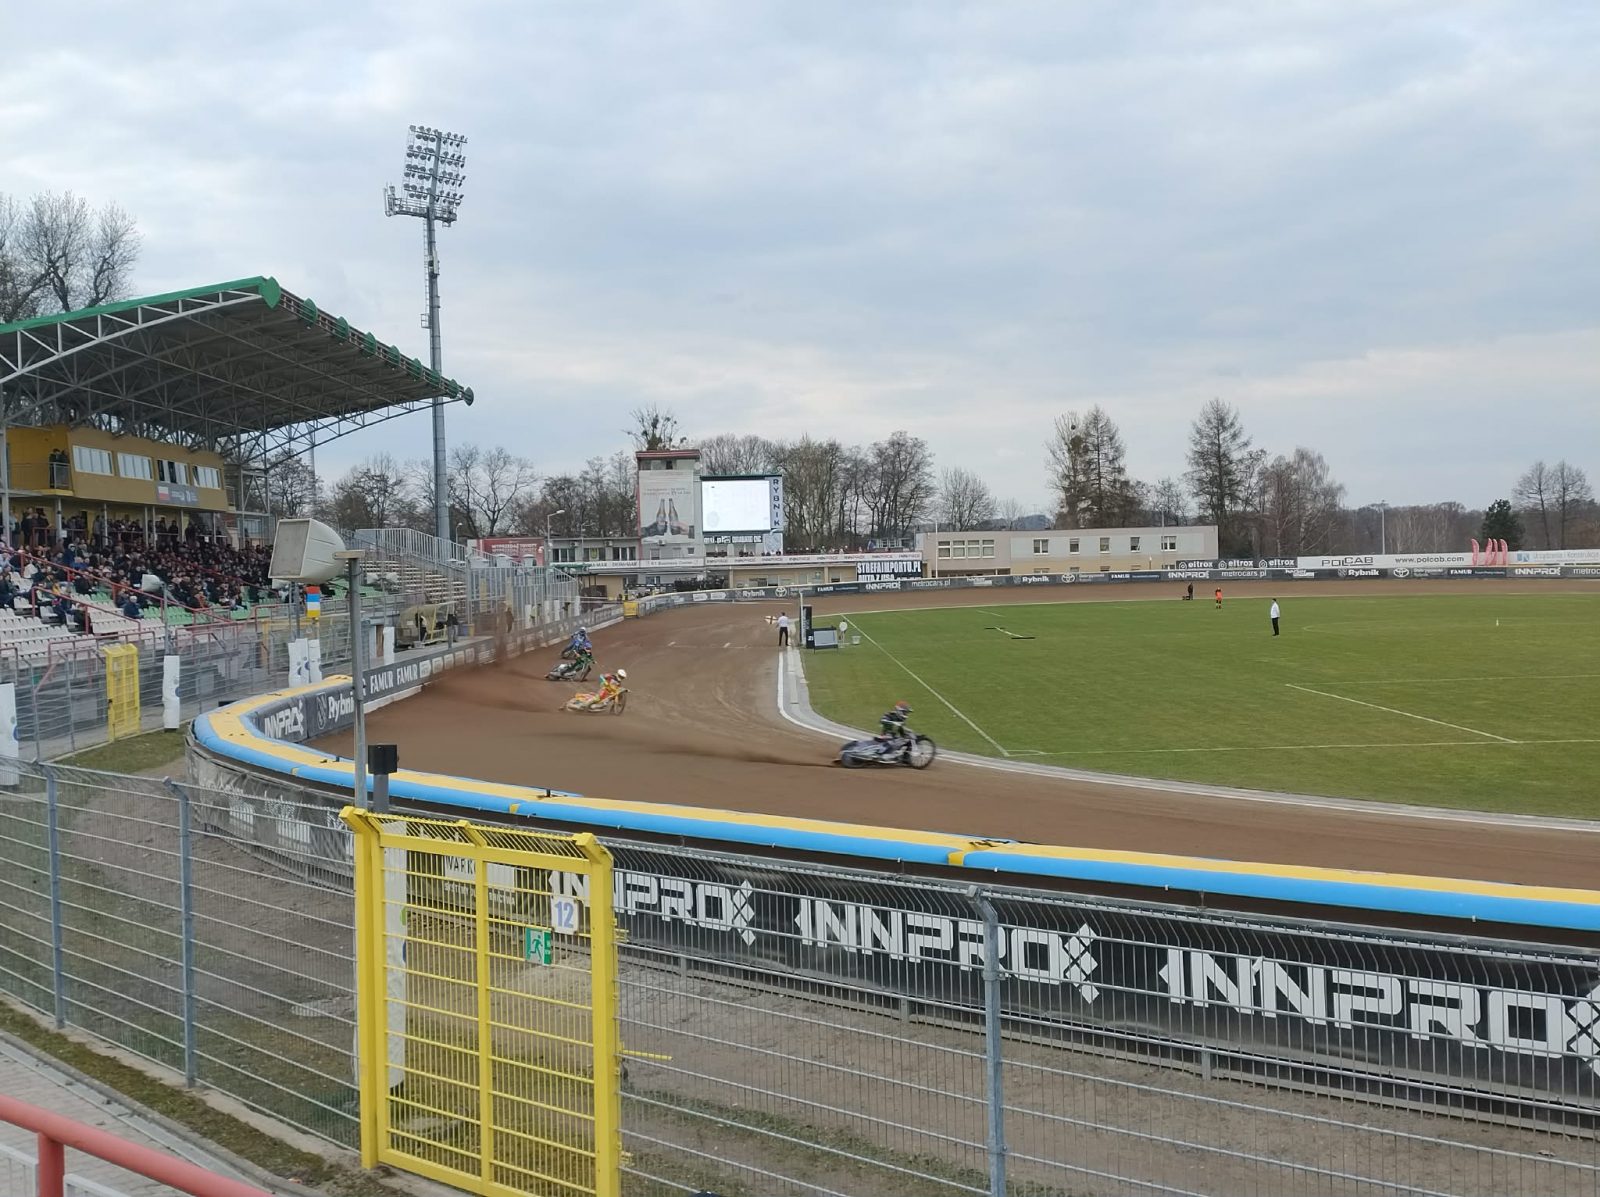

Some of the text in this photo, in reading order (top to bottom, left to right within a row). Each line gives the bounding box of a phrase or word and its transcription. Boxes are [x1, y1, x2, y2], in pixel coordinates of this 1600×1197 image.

[857, 561, 921, 573] STREFAIMPORTU.PL
[1322, 557, 1373, 566] POLCAB
[1348, 569, 1379, 577] Rybnik
[370, 670, 394, 695] FAMUR
[396, 663, 418, 686] FAMUR
[328, 691, 354, 722] Rybni
[555, 902, 574, 929] 12
